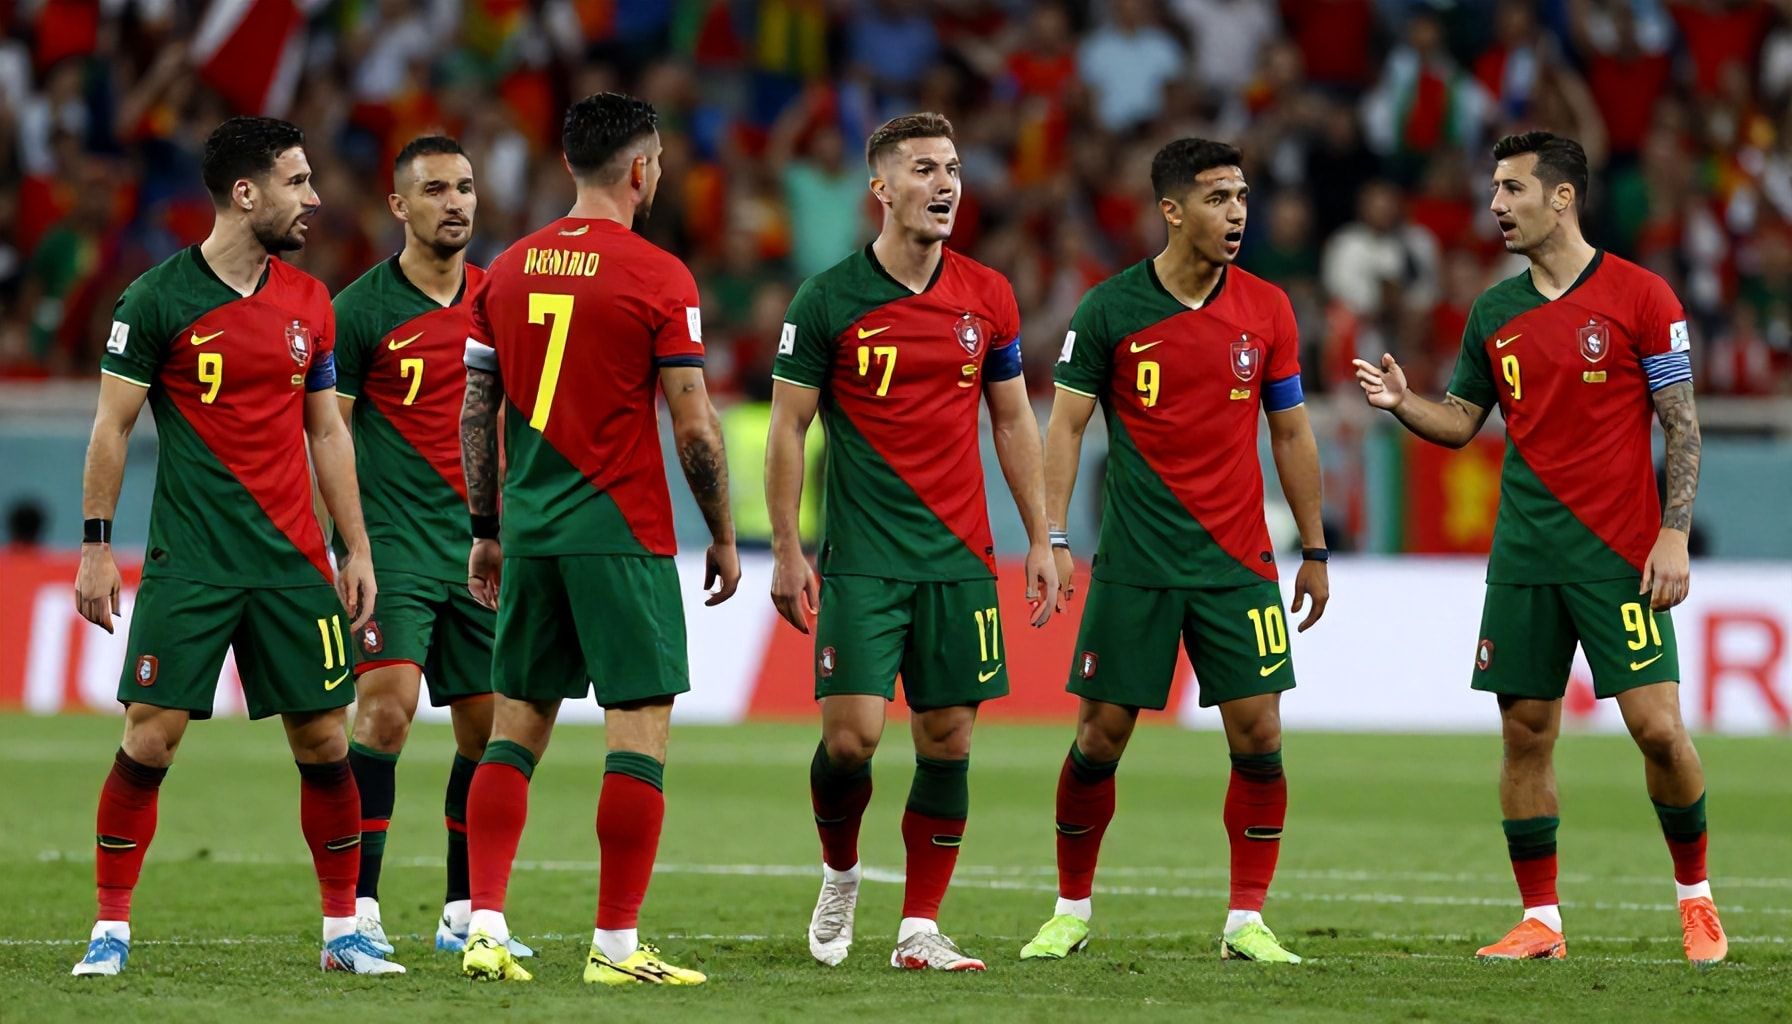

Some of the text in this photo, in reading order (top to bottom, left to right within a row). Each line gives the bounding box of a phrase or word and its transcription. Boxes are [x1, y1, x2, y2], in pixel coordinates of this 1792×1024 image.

[198, 352, 223, 404] 9
[399, 358, 424, 406] 7
[528, 293, 575, 432] 7
[1136, 361, 1160, 408] 9
[1501, 354, 1521, 400] 9
[317, 614, 346, 670] 11
[974, 607, 998, 661] 17
[1248, 606, 1287, 657] 10
